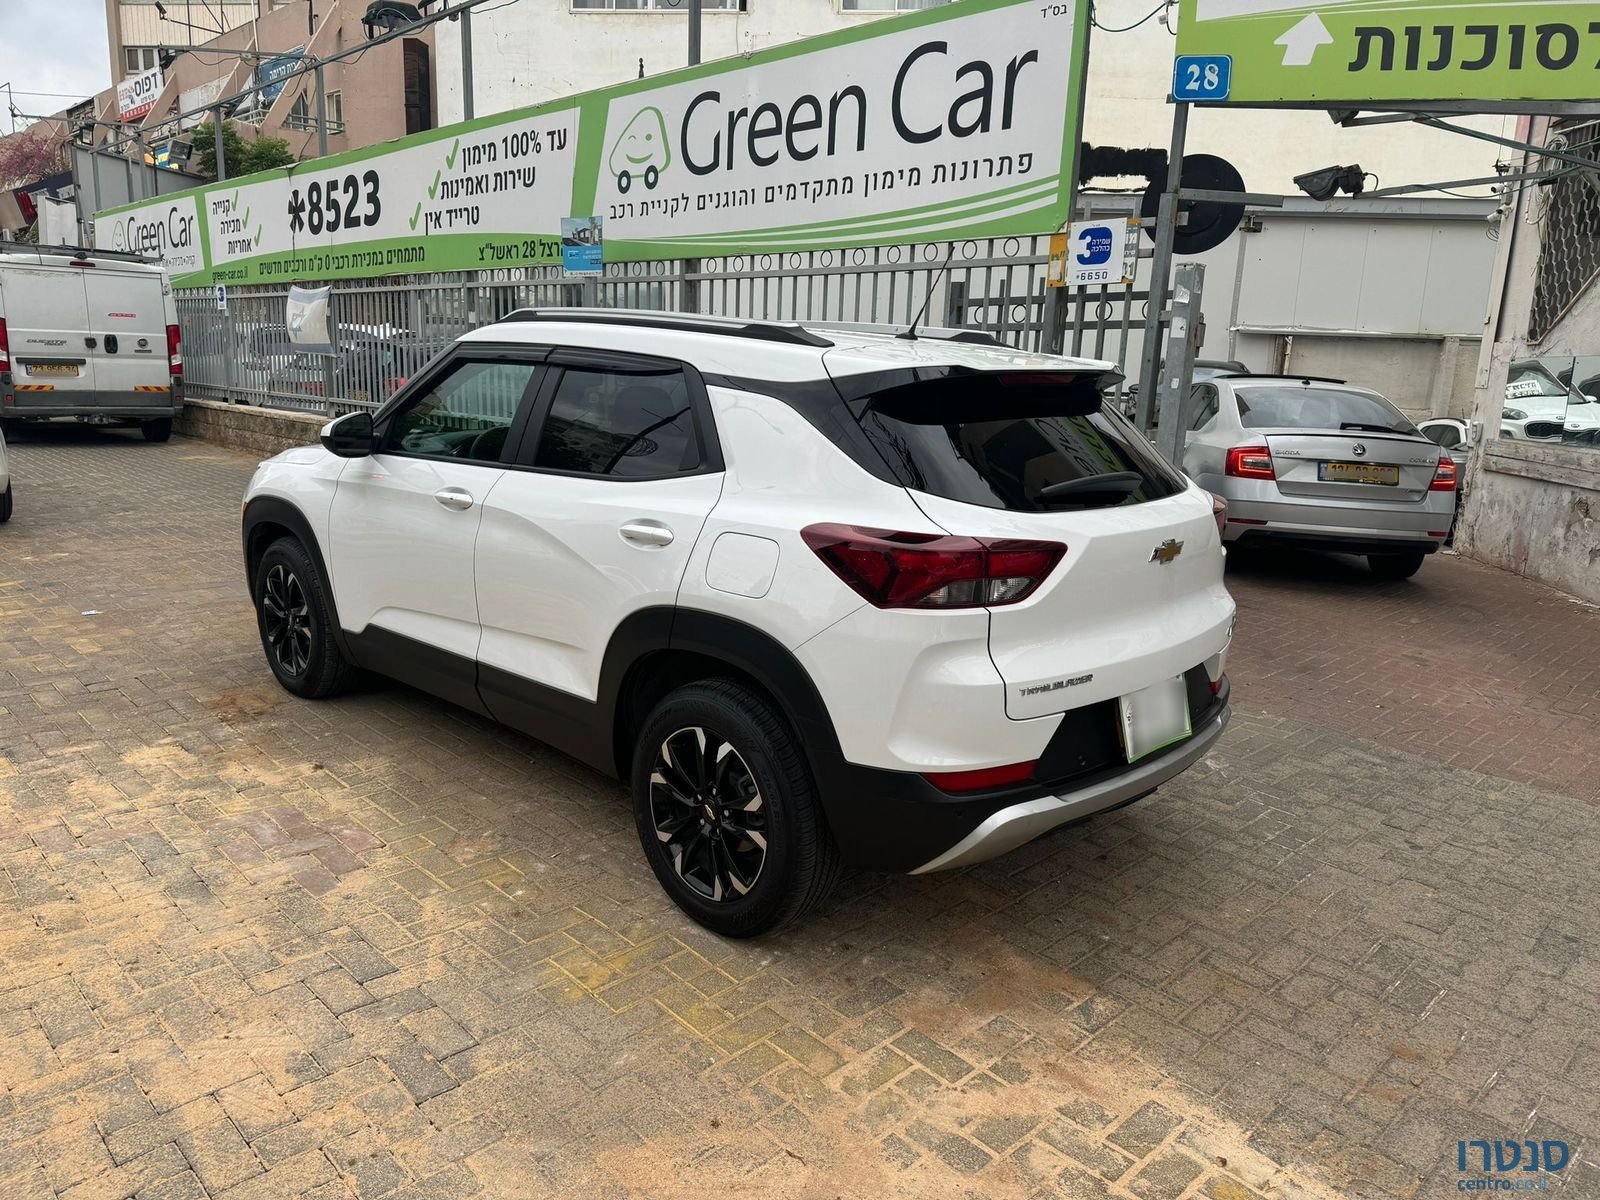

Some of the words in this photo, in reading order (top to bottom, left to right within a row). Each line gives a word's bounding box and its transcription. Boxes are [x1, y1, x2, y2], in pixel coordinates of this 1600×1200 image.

[1041, 4, 1067, 18] בס"ד
[134, 72, 157, 97] דפוס
[1185, 63, 1219, 91] 28
[680, 84, 868, 176] Green
[891, 40, 1038, 145] Car
[502, 130, 542, 159] 100%
[546, 128, 567, 151] עד
[462, 142, 497, 173] מימון
[932, 152, 1033, 184] פתרונות
[440, 174, 489, 200] ואמינות
[493, 167, 536, 192] שירות
[864, 167, 921, 198] מימון
[697, 188, 756, 211] והוגנים
[764, 176, 853, 204] מתקדמים
[213, 199, 231, 217] קנייה
[609, 203, 634, 220] רכב
[639, 193, 690, 219] לקניית
[220, 216, 241, 235] מכירה
[424, 210, 442, 236] אין
[446, 206, 480, 228] טרייד
[127, 216, 167, 254] Green
[168, 206, 194, 248] Car
[228, 238, 252, 255] אחריות
[387, 246, 425, 265] מתמחים
[479, 243, 519, 260] ראשל"צ
[522, 240, 536, 258] 28
[540, 239, 563, 257] רצל
[259, 261, 282, 275] חדשים
[284, 258, 307, 273] ורכבים
[308, 255, 323, 272] ק"מ
[325, 254, 331, 271] 0
[332, 254, 350, 270] רכבי
[351, 250, 384, 268] במכירת
[212, 266, 248, 283] green-car.co.il
